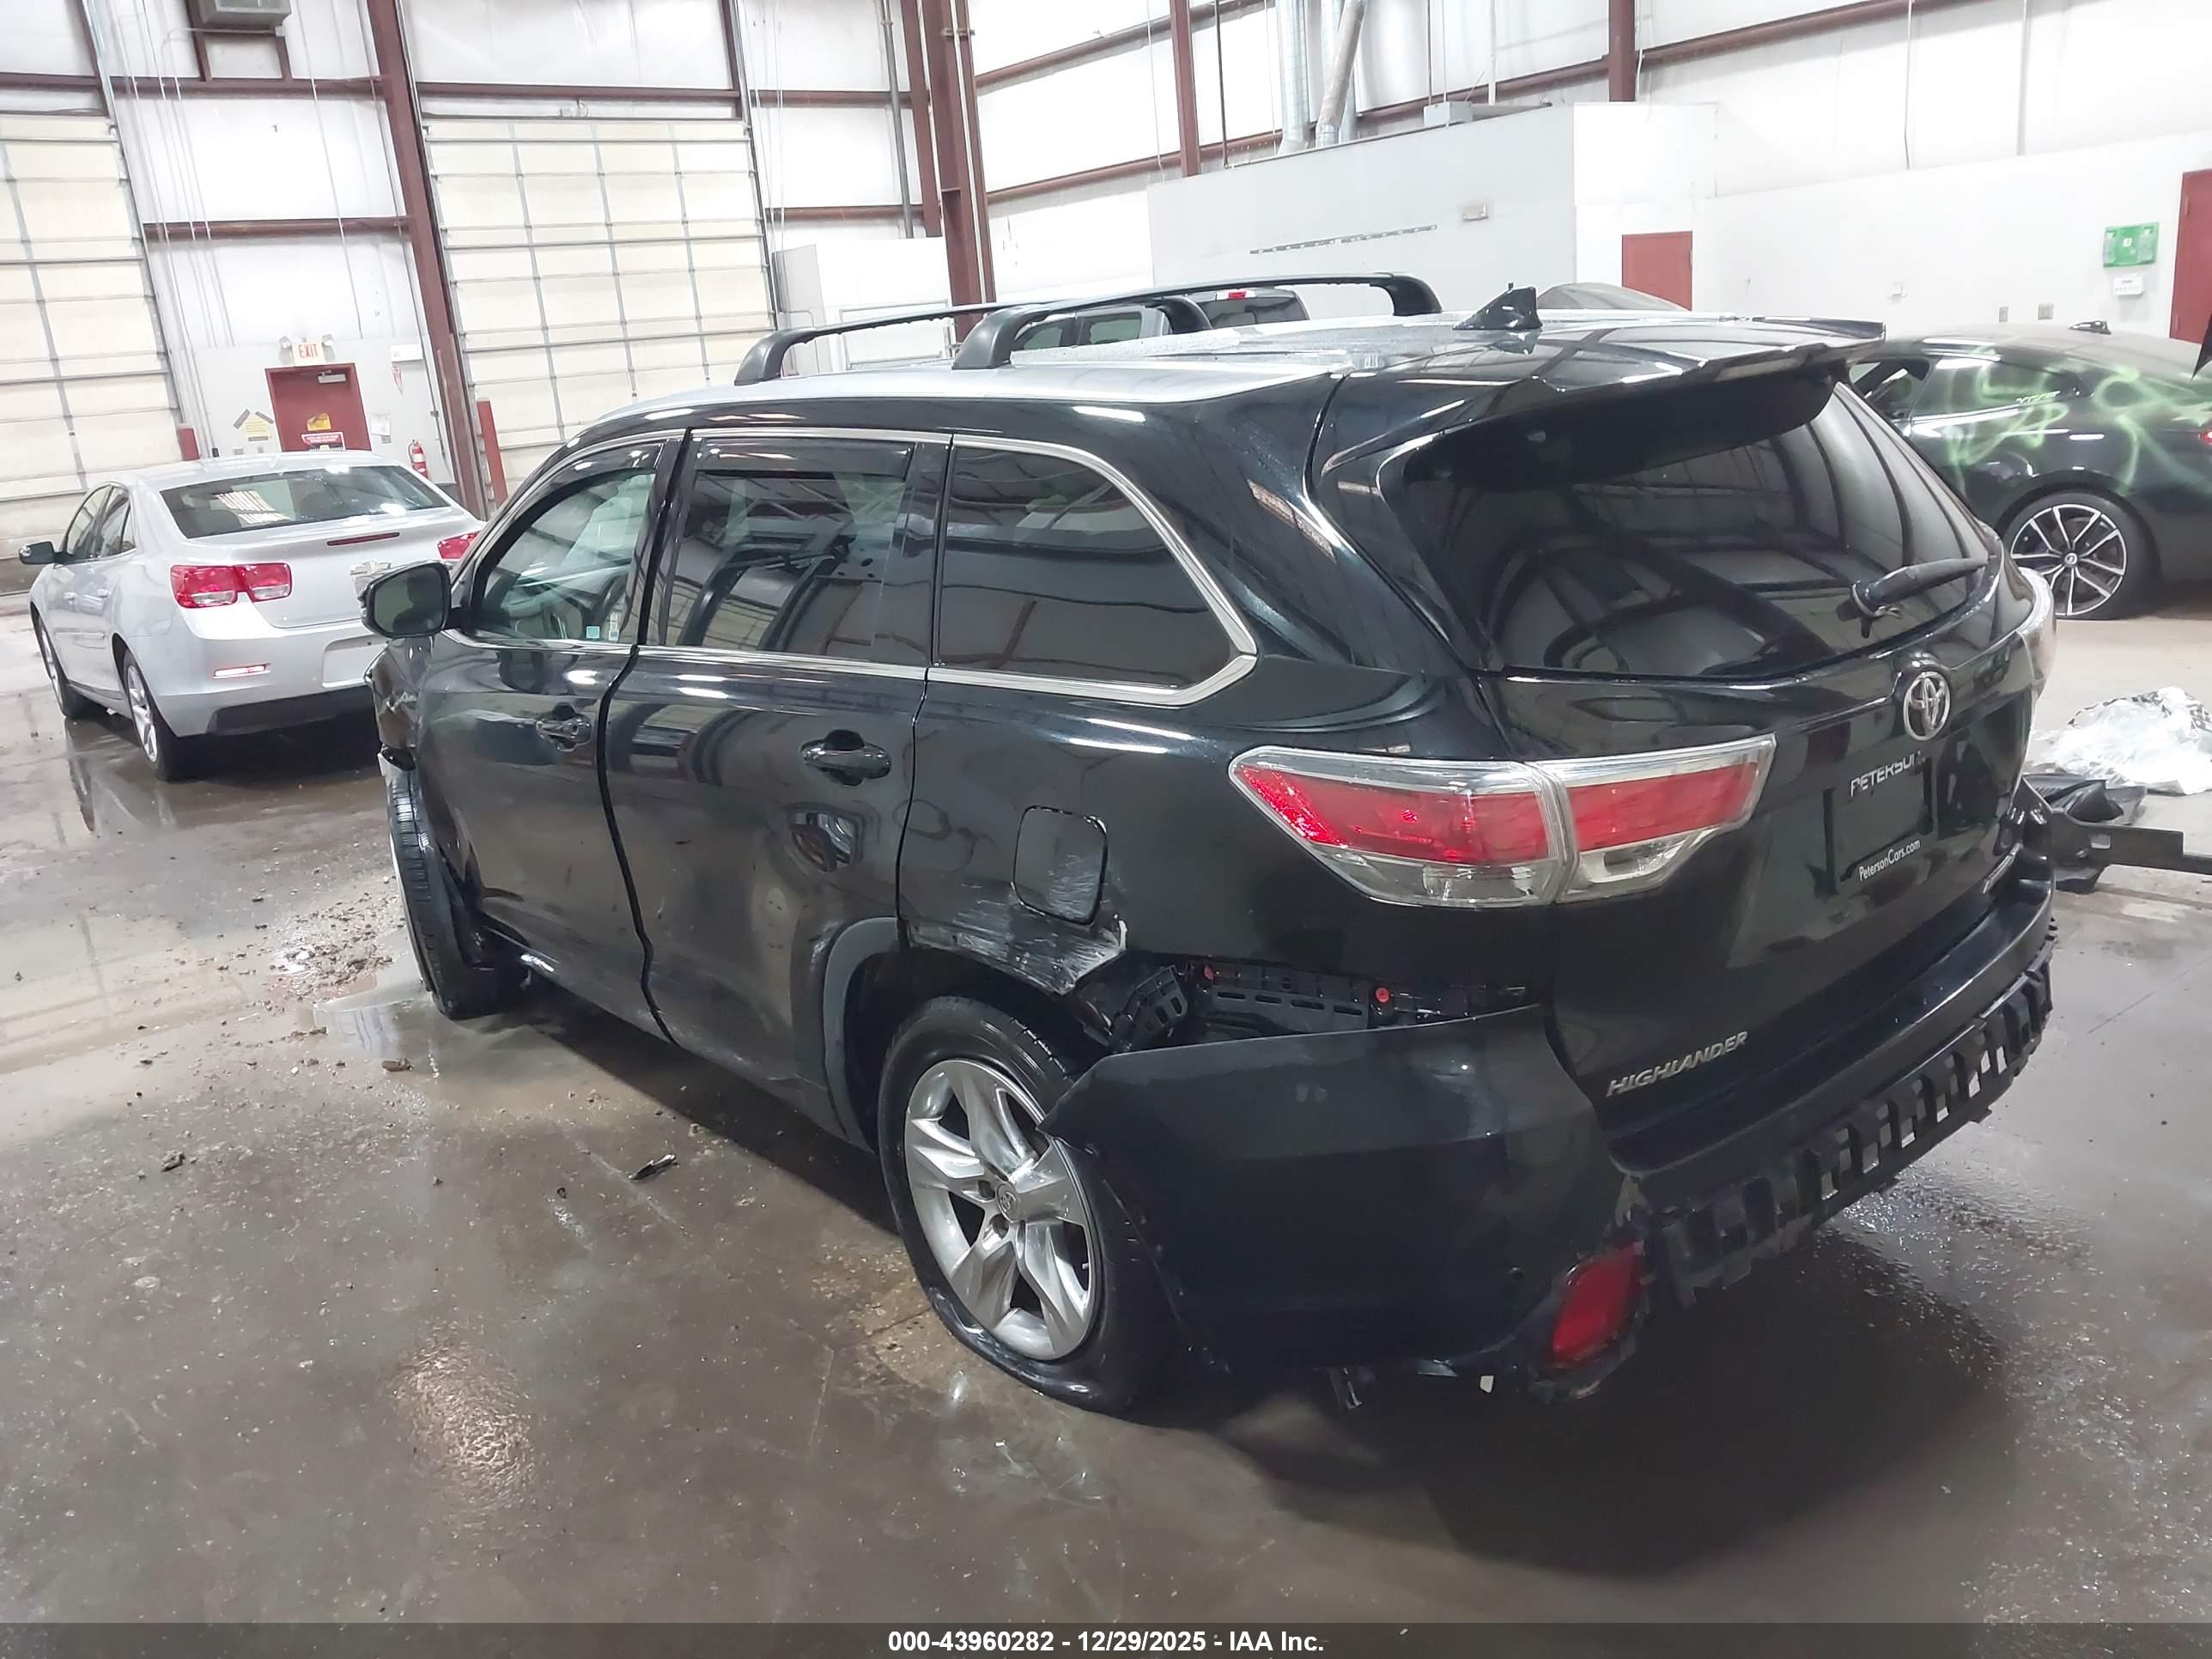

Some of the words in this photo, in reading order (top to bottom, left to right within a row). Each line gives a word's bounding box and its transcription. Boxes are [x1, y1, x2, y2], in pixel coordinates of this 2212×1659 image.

[298, 343, 318, 358] EXIT
[1858, 838, 1922, 883] PetersonCars.com
[1605, 1030, 1749, 1099] HIGHLANDER
